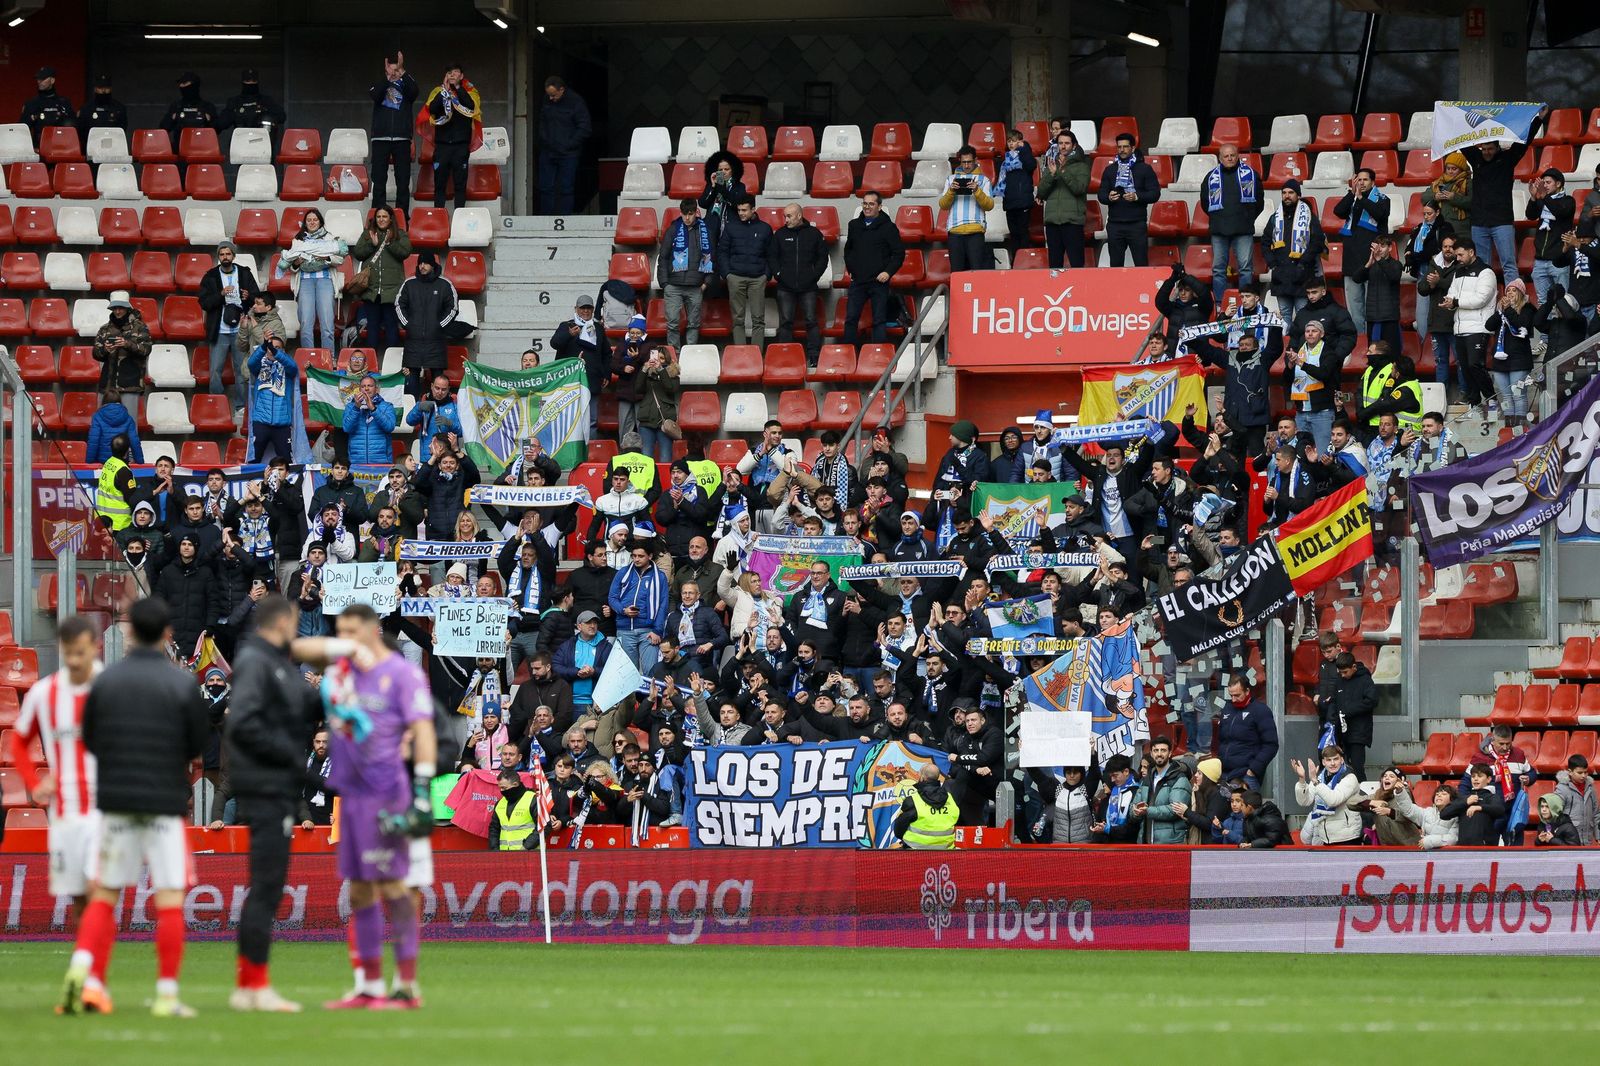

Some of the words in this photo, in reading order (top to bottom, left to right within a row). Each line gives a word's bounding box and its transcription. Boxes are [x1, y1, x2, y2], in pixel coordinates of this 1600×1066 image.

[503, 217, 513, 228] G
[554, 219, 565, 231] 8
[604, 217, 613, 228] H
[547, 247, 558, 260] 7
[539, 291, 550, 304] 6
[1089, 313, 1150, 338] viajes
[532, 339, 543, 351] 5
[1480, 422, 1490, 436] 3
[38, 481, 98, 509] PEÑ
[495, 491, 572, 502] INVENCIBLES
[1419, 467, 1528, 538] LOS
[1288, 501, 1372, 569] MOLLINA
[1460, 538, 1491, 554] Peña
[1493, 500, 1563, 544] Malaguista
[425, 545, 437, 556] A.
[440, 545, 492, 555] HERRERO
[440, 605, 473, 622] FUNES
[1160, 592, 1185, 622] EL
[1225, 626, 1244, 639] CLUB
[1246, 618, 1256, 629] DE
[984, 640, 1020, 652] FRENTE
[691, 750, 780, 797] LOS
[791, 748, 855, 795] DE
[697, 792, 874, 848] SIEMPRE
[965, 882, 1094, 942] ribera
[1335, 861, 1553, 948] ¡Saludos
